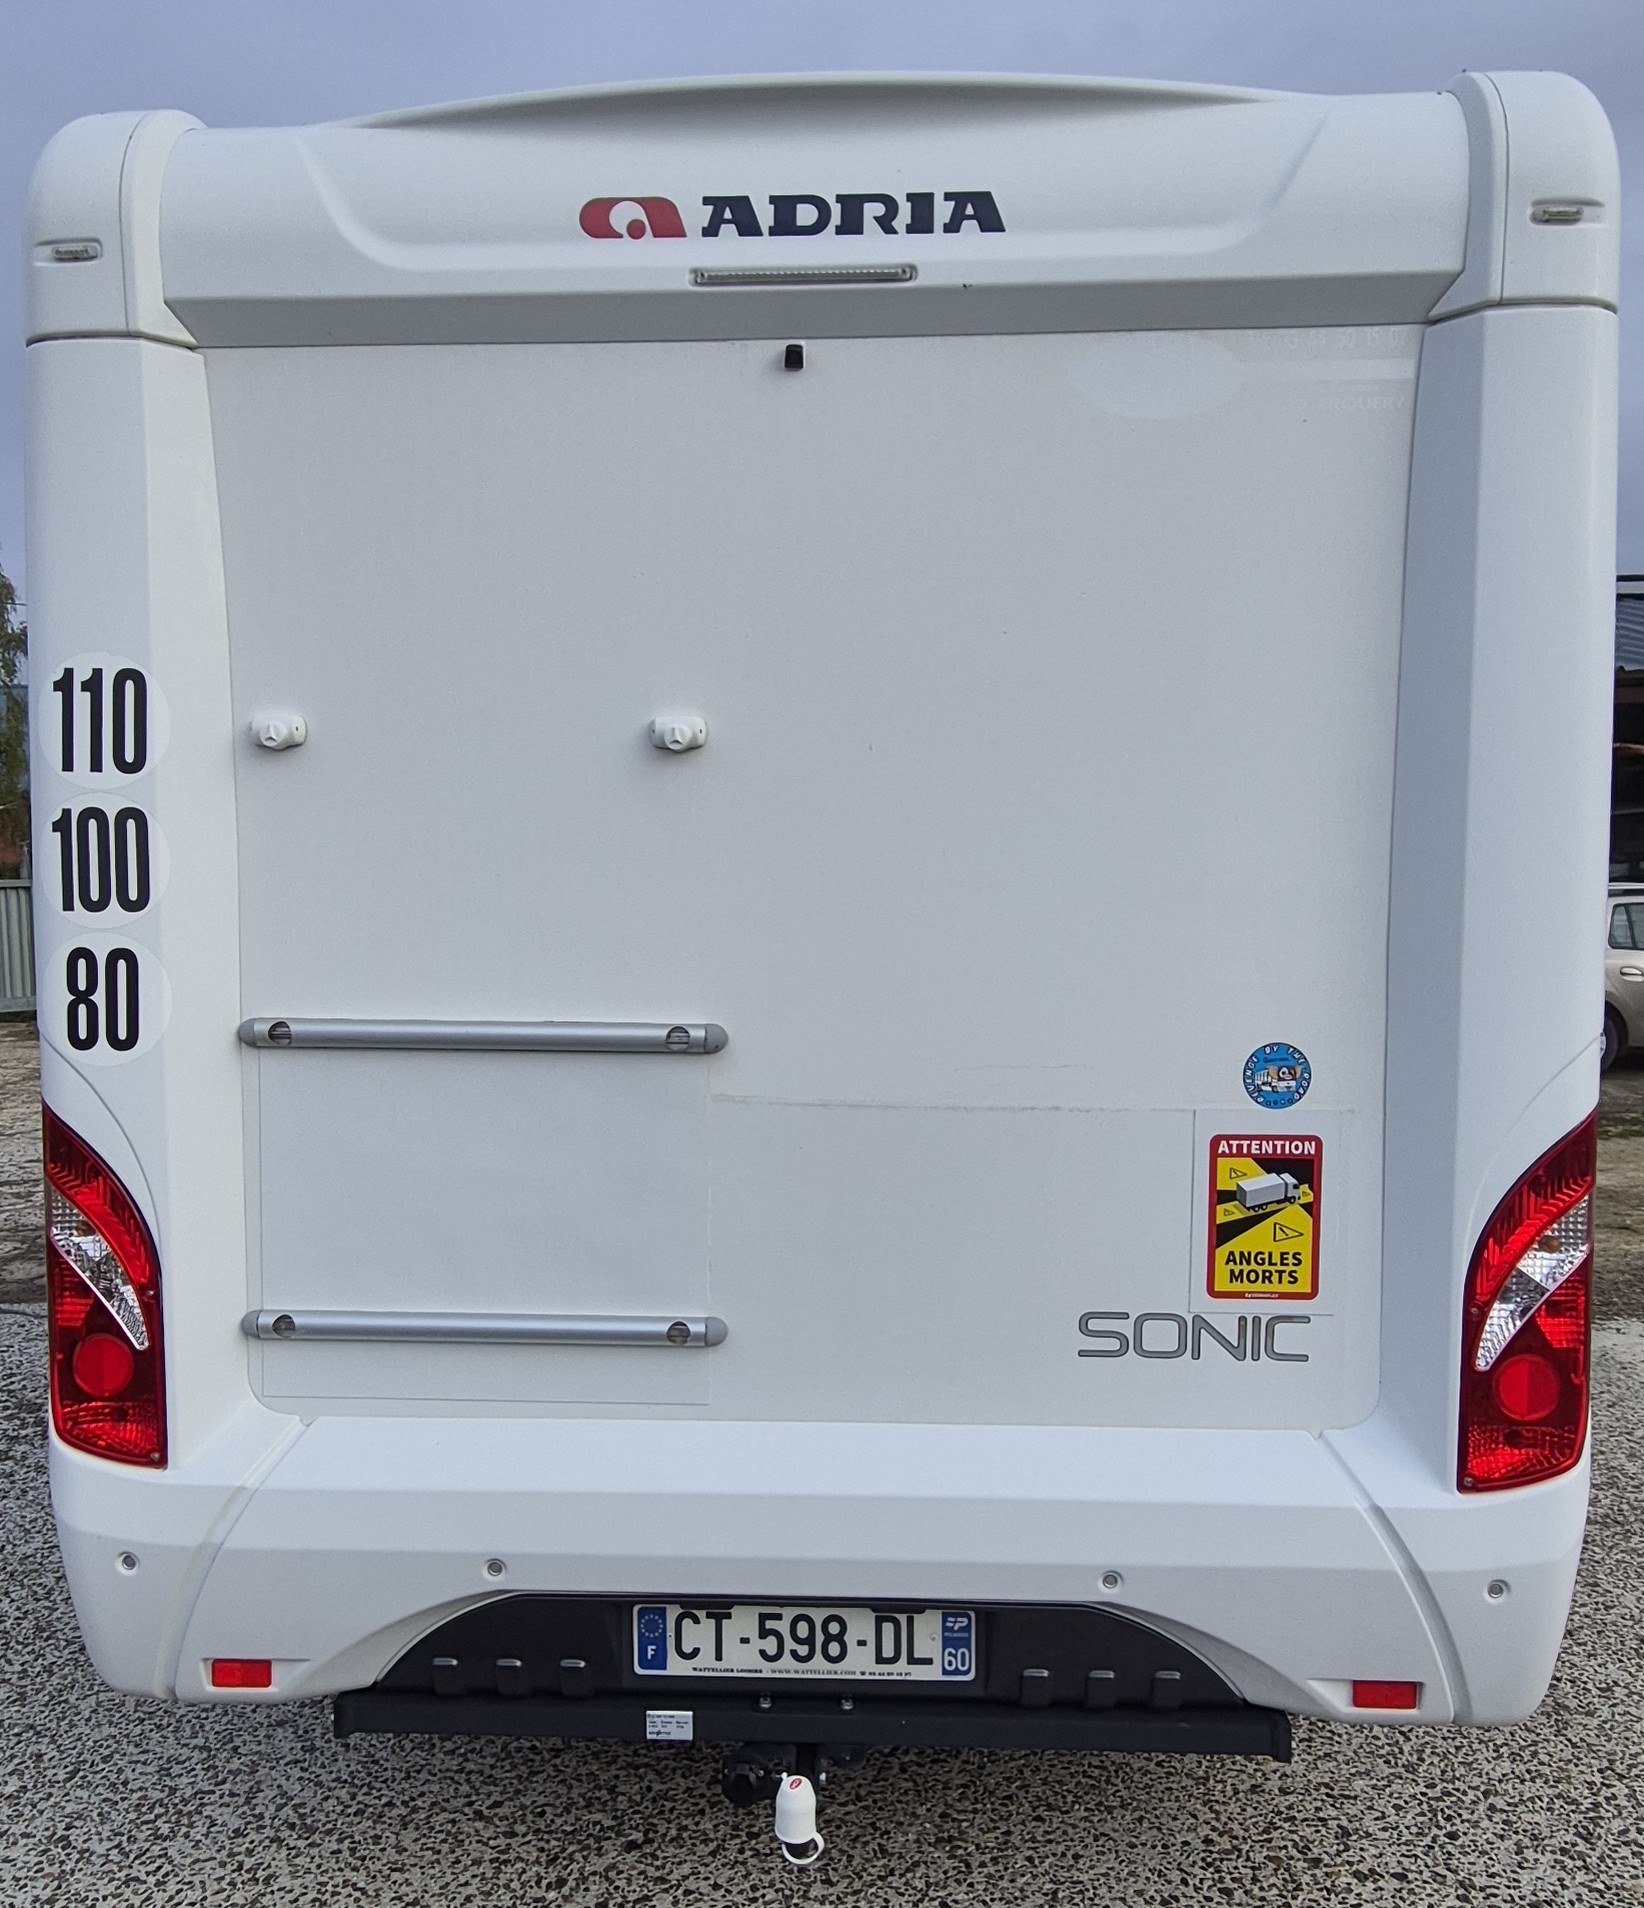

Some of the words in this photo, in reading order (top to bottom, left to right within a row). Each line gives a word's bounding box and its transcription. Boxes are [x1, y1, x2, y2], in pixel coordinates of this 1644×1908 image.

[701, 190, 1007, 238] ADRIA
[52, 667, 148, 775] 110
[51, 806, 151, 914] 100
[66, 946, 139, 1053] 80
[1264, 1045, 1278, 1054] BY
[1287, 1046, 1305, 1064] THE
[1293, 1072, 1310, 1100] ROAD
[1218, 1140, 1316, 1155] ATTENTION
[1225, 1250, 1303, 1267] ANGLES
[1229, 1268, 1299, 1285] MORTS
[1077, 1311, 1312, 1363] SONIC
[674, 1610, 934, 1666] CT-598-DL
[646, 1645, 657, 1660] F
[943, 1647, 971, 1673] 60
